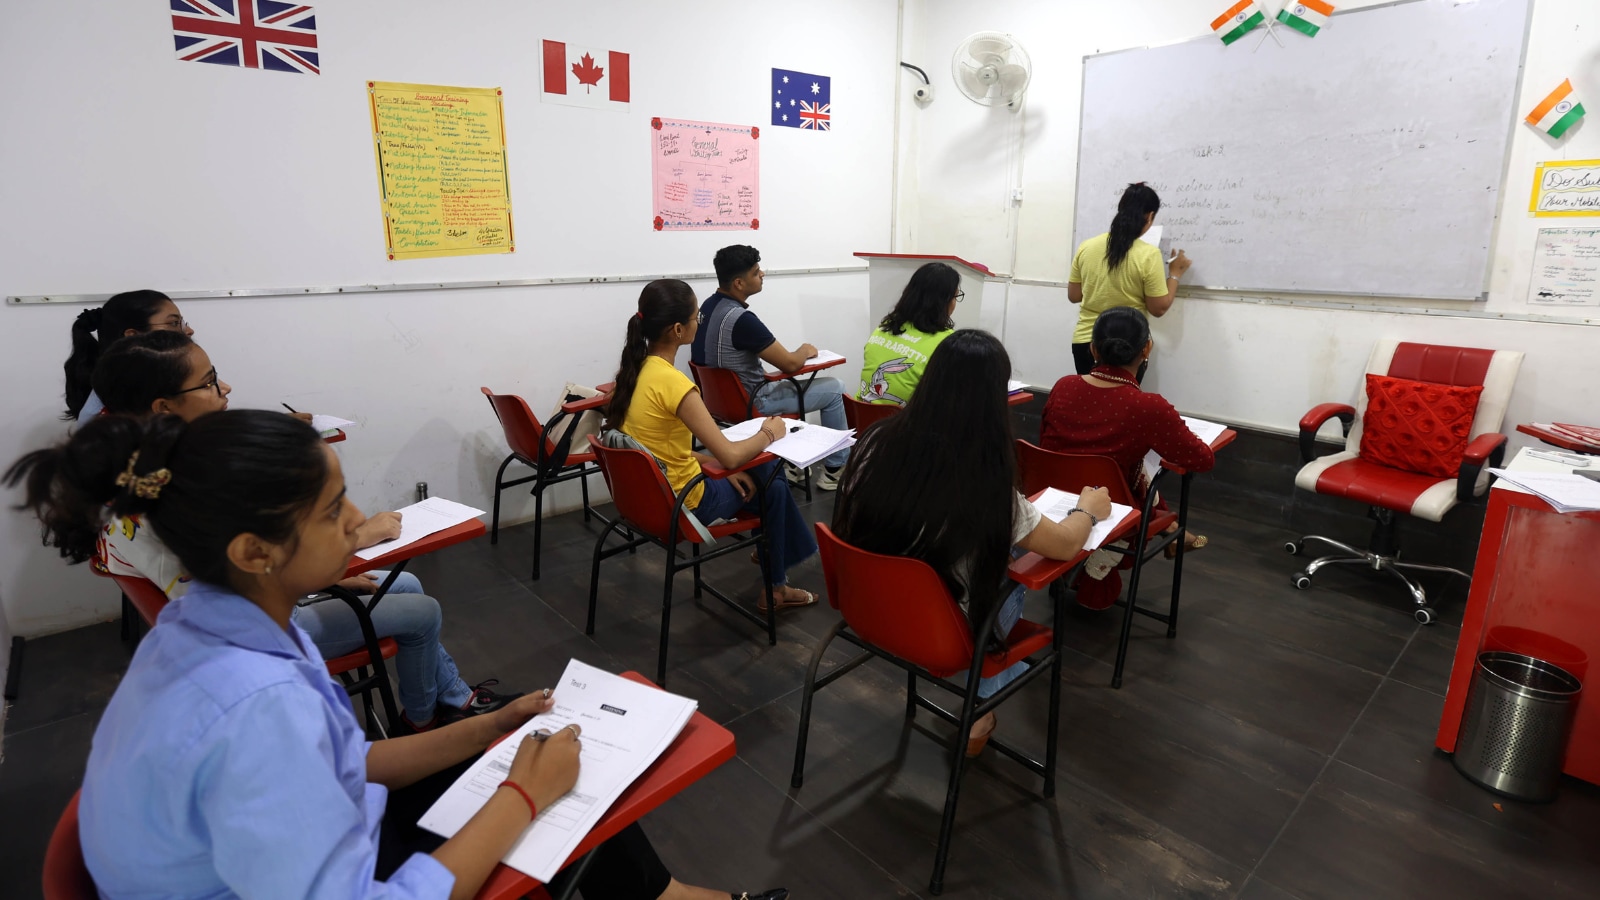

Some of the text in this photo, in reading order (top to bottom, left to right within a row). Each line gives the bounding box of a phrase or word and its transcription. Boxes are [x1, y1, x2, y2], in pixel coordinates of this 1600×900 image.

[691, 136, 719, 151] General
[1547, 172, 1574, 187] Do
[1545, 194, 1569, 207] Your
